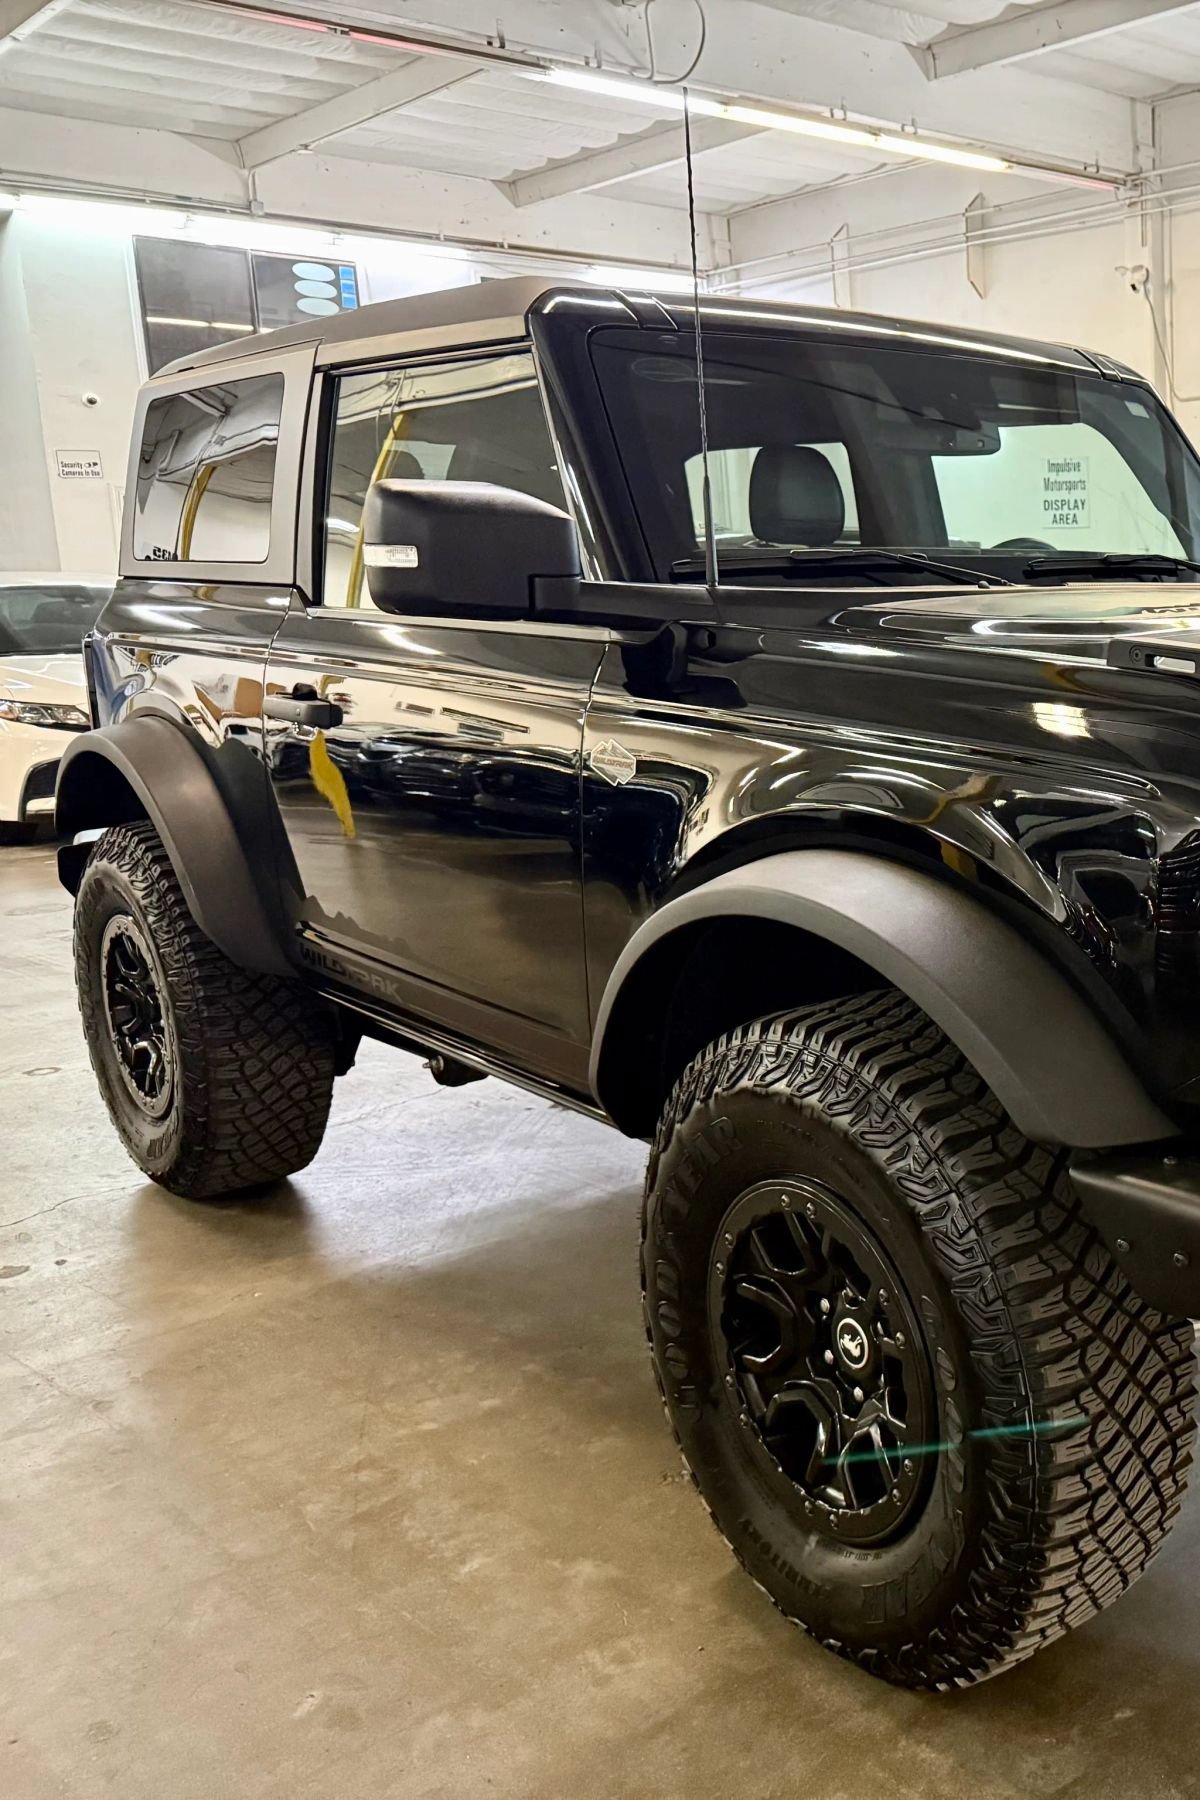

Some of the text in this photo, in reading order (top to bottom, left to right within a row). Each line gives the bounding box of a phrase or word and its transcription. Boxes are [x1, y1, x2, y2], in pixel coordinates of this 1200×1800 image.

[60, 461, 83, 469] Security
[1047, 458, 1081, 476] Impulsive
[1043, 477, 1086, 494] Motorsports
[1043, 498, 1086, 512] DISPLAY
[1052, 513, 1078, 525] AREA
